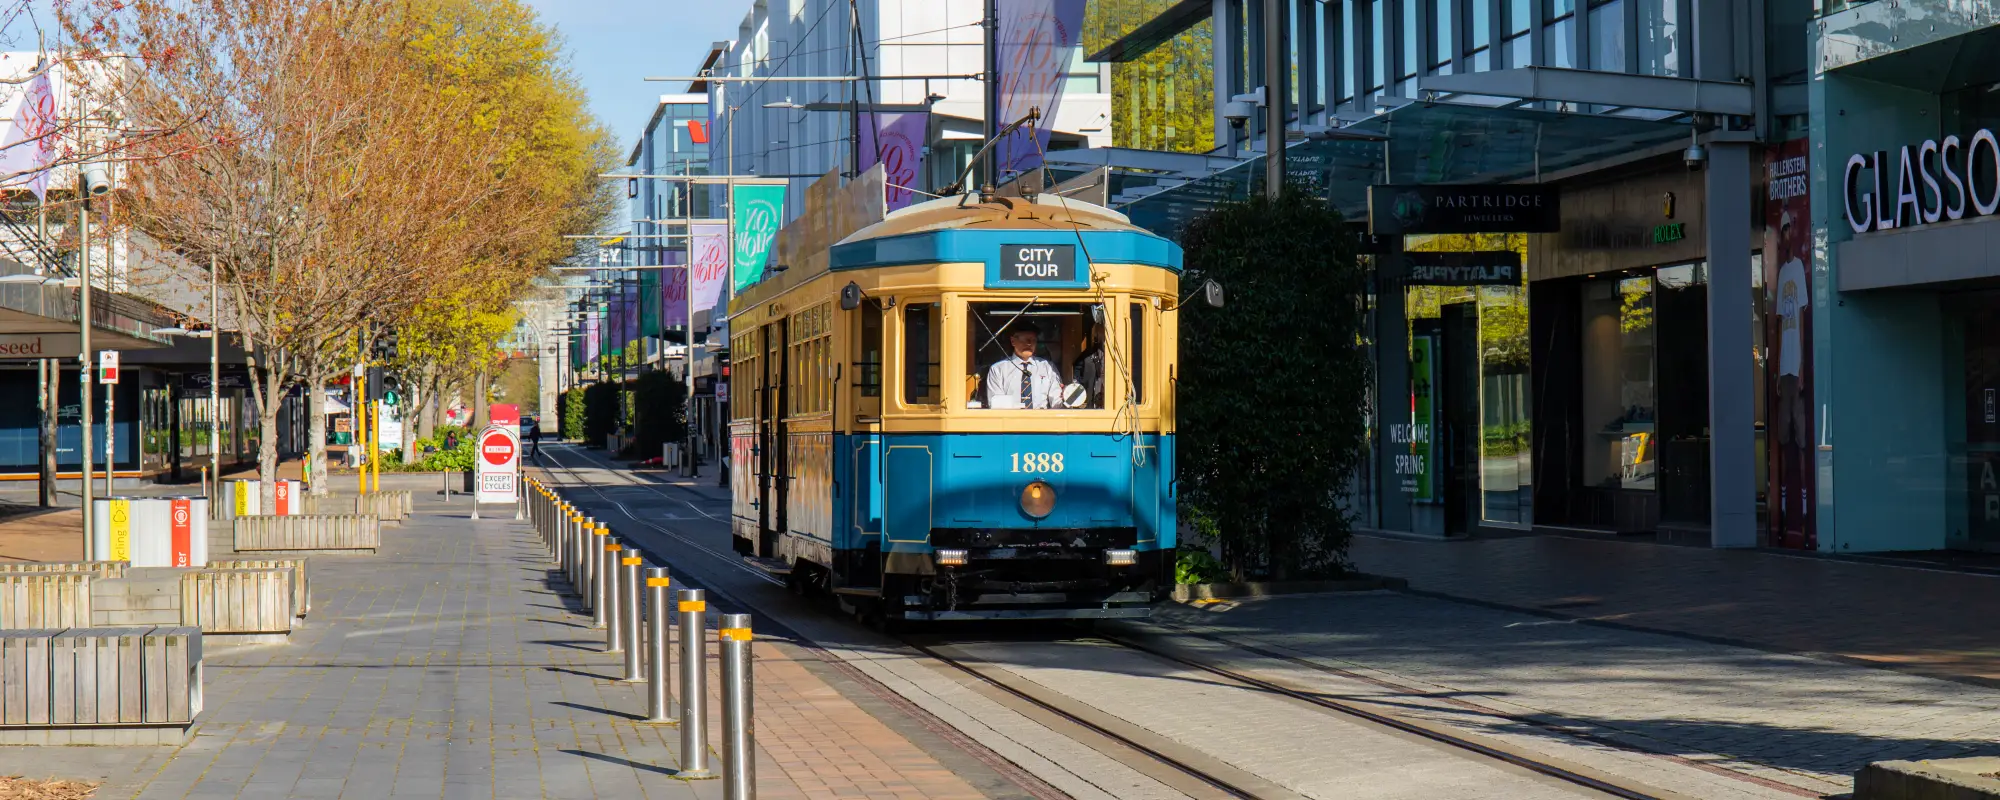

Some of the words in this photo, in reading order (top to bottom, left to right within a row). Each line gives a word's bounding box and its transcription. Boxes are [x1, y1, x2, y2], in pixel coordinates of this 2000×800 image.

[1769, 155, 1806, 178] HALLENSTEIN
[1769, 174, 1807, 200] BROTHERS
[1844, 128, 2000, 234] GLASSO
[1435, 194, 1542, 208] PARTRIDGE
[1464, 214, 1514, 223] JEWELLERS
[1653, 223, 1683, 243] ROLEX
[1019, 248, 1054, 262] CITY
[1014, 263, 1059, 277] TOUR
[0, 336, 43, 355] seed
[1390, 423, 1429, 444] WELCOME
[1010, 452, 1064, 473] 1888
[1395, 454, 1425, 475] SPRING
